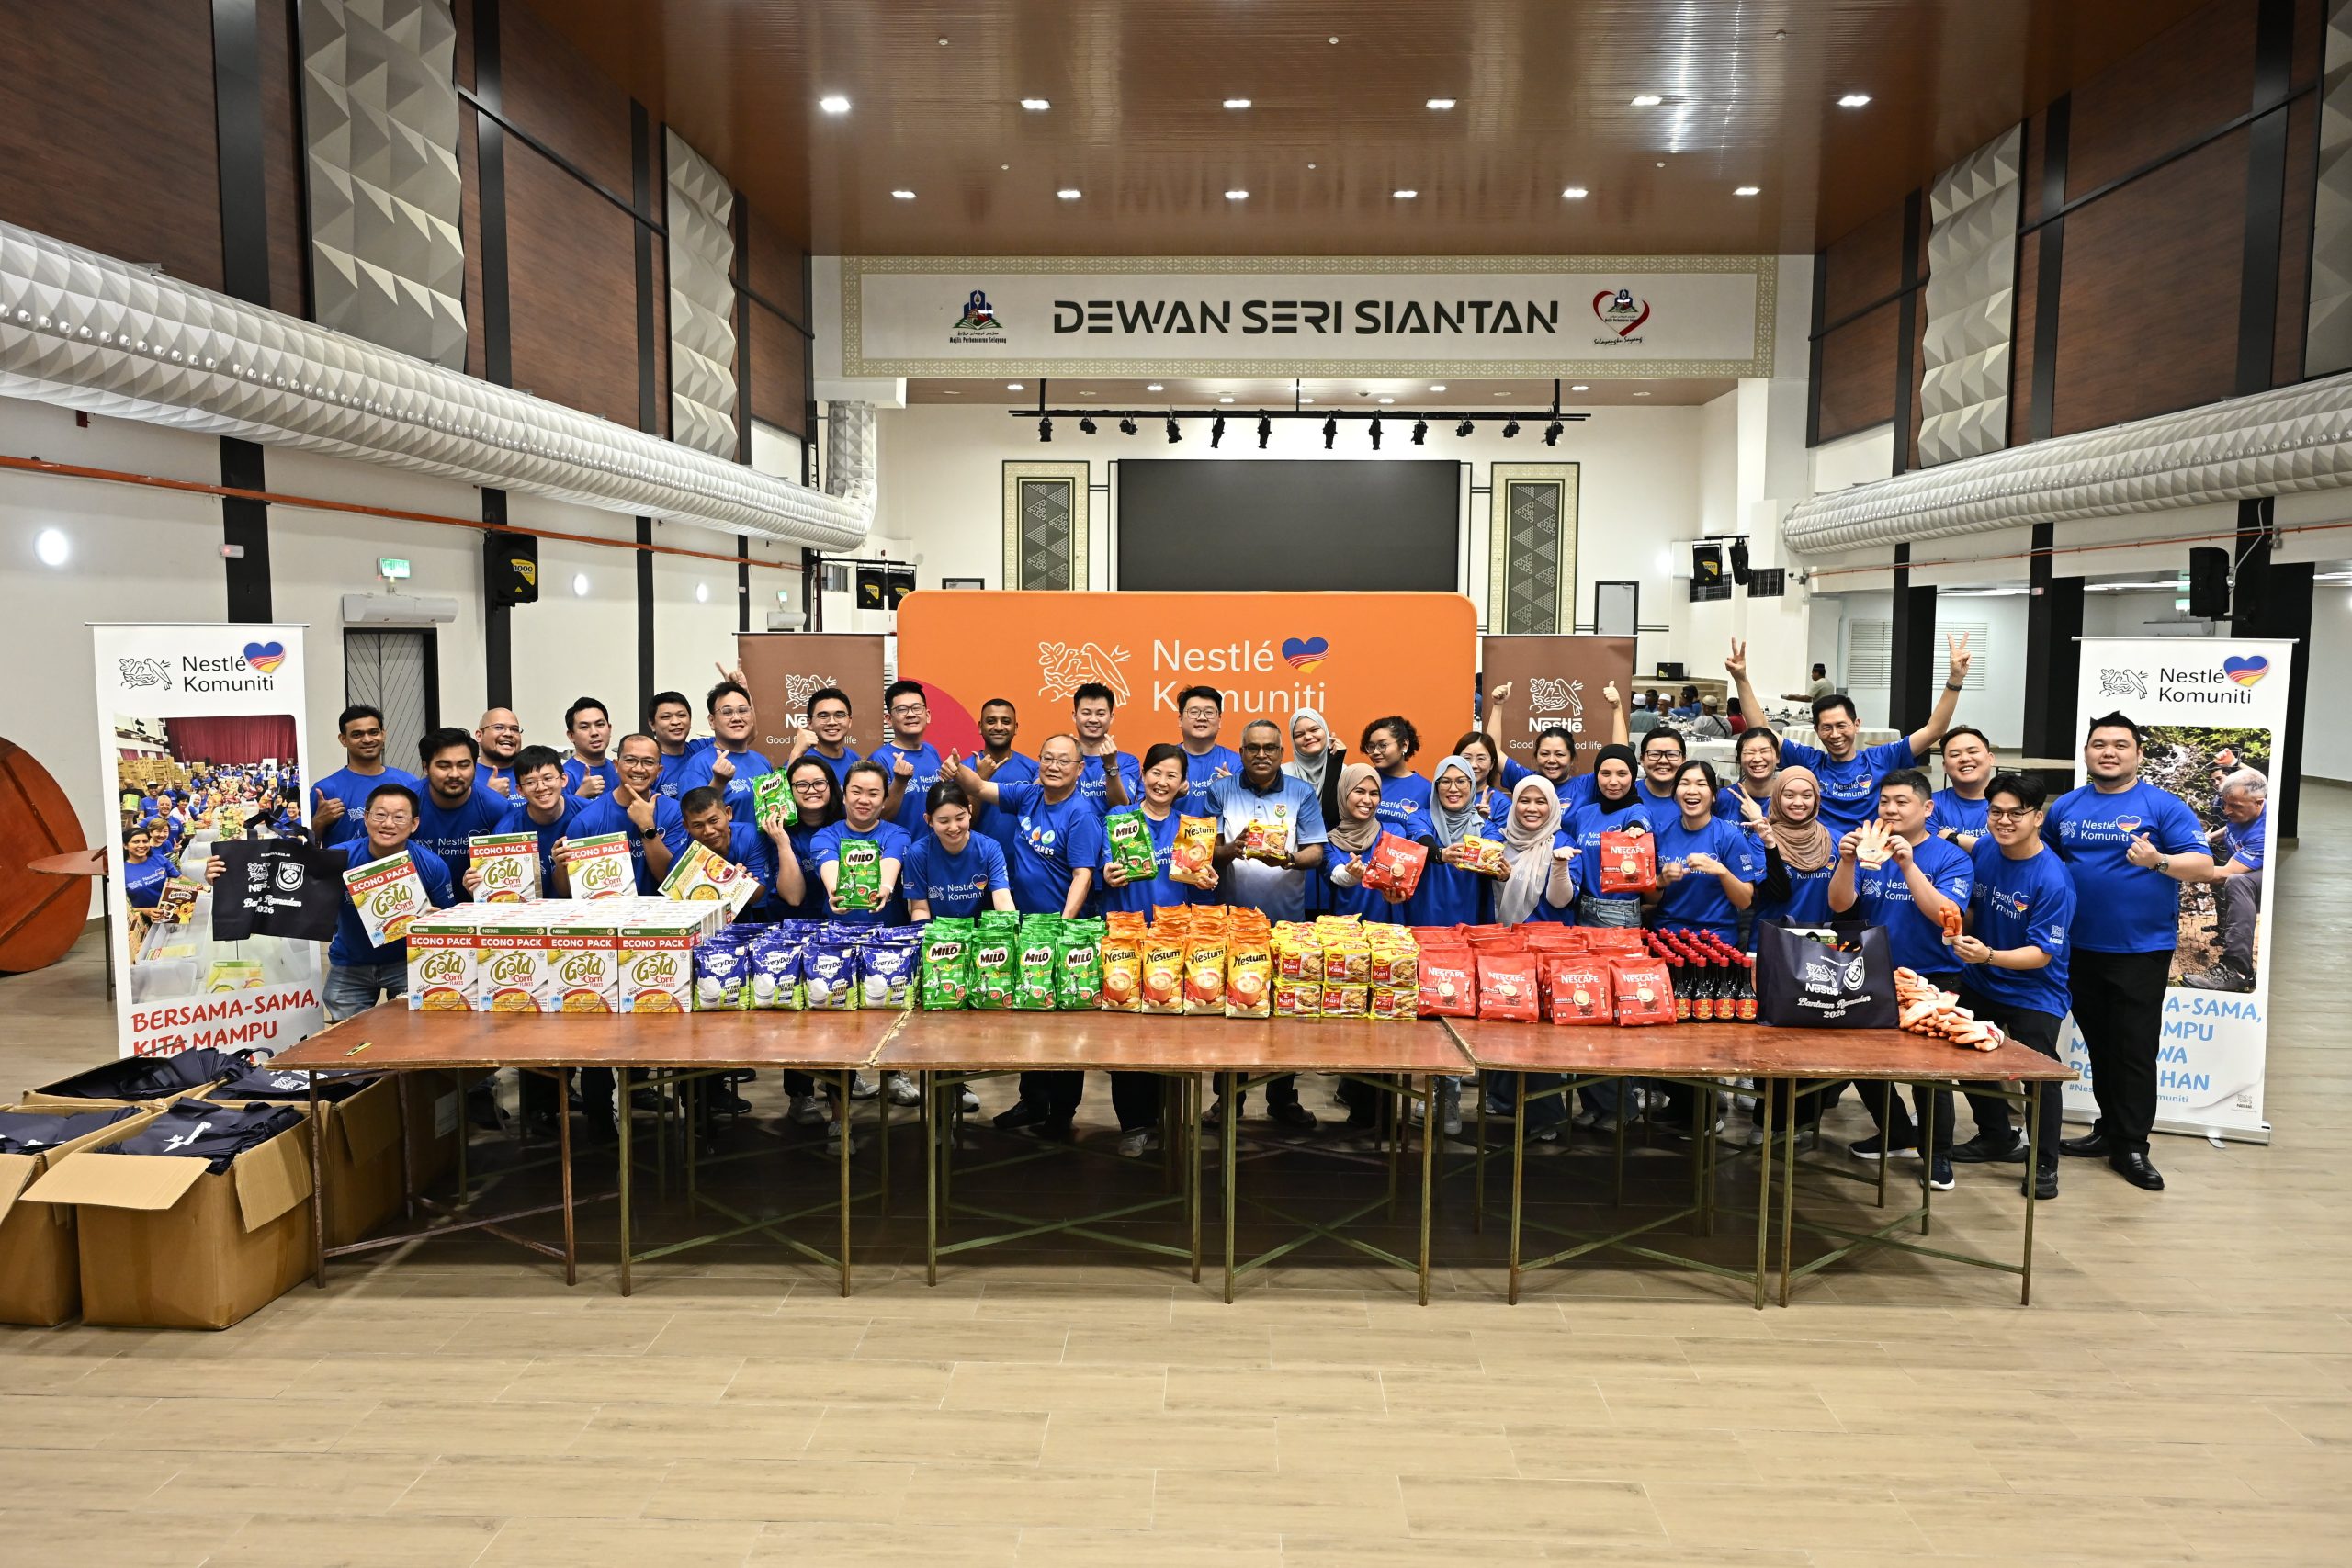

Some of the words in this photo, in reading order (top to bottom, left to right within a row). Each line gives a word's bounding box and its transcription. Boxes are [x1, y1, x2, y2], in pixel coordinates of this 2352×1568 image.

[1054, 300, 1230, 333] DEWAN
[1242, 300, 1342, 333] SERI
[1355, 300, 1558, 333] SIANTAN
[1153, 640, 1274, 671] Nestlé
[182, 655, 246, 672] Nestlé
[2159, 668, 2224, 684] Nestlé
[184, 675, 274, 693] Komuniti
[1153, 680, 1326, 713] Kmuniti
[2159, 687, 2252, 704] Komuniti
[766, 736, 790, 744] Good
[844, 736, 856, 744] life
[1510, 740, 1533, 749] Good
[1589, 740, 1602, 750] life
[761, 778, 780, 793] MILO
[1832, 781, 1858, 790] Nestlé
[1832, 788, 1870, 797] Komuniti
[1380, 801, 1400, 809] estlé
[1376, 808, 1408, 820] omuniti
[2082, 819, 2116, 830] Nestlé
[1115, 825, 1138, 838] MILO
[1184, 825, 1215, 840] Nestum
[2080, 830, 2129, 842] Komuniti
[438, 837, 469, 845] Nestlé
[474, 847, 502, 856] ECONO
[570, 848, 599, 859] ECONO
[603, 844, 625, 853] PACK
[1154, 845, 1174, 857] estlé
[849, 852, 873, 863] MILO
[353, 875, 384, 892] ECONO
[386, 865, 411, 880] PACK
[488, 862, 518, 885] Gold
[586, 862, 618, 886] Gold
[1797, 872, 1831, 880] Komunit
[947, 882, 974, 893] Nestlé
[375, 884, 410, 915] Gold
[1885, 891, 1915, 901] Komun
[395, 900, 413, 911] Corn
[412, 937, 444, 946] ECONO
[447, 937, 472, 946] PACK
[551, 939, 584, 947] ECONO
[587, 939, 612, 947] PACK
[623, 940, 656, 948] ECONO
[660, 940, 684, 948] PACK
[931, 946, 958, 957] MILO
[980, 952, 1006, 963] MILO
[1024, 952, 1049, 963] MILO
[1104, 950, 1136, 964] Nestum
[1146, 950, 1180, 964] Nestum
[1192, 949, 1224, 964] Nestum
[1068, 953, 1091, 964] MILO
[1233, 953, 1267, 968] Nestum
[424, 956, 461, 979] Gold
[494, 957, 531, 981] Gold
[564, 958, 601, 981] Gold
[636, 959, 673, 981] Gold
[814, 961, 844, 971] EveryDay
[513, 975, 533, 983] Corn
[1797, 997, 1835, 1009] Bantuan
[130, 988, 320, 1032] BERSAMA-SAMA,
[1823, 1009, 1846, 1019] 2026
[2160, 1021, 2213, 1042] MPU
[133, 1034, 186, 1058] KITA
[192, 1020, 277, 1049] MAMPU
